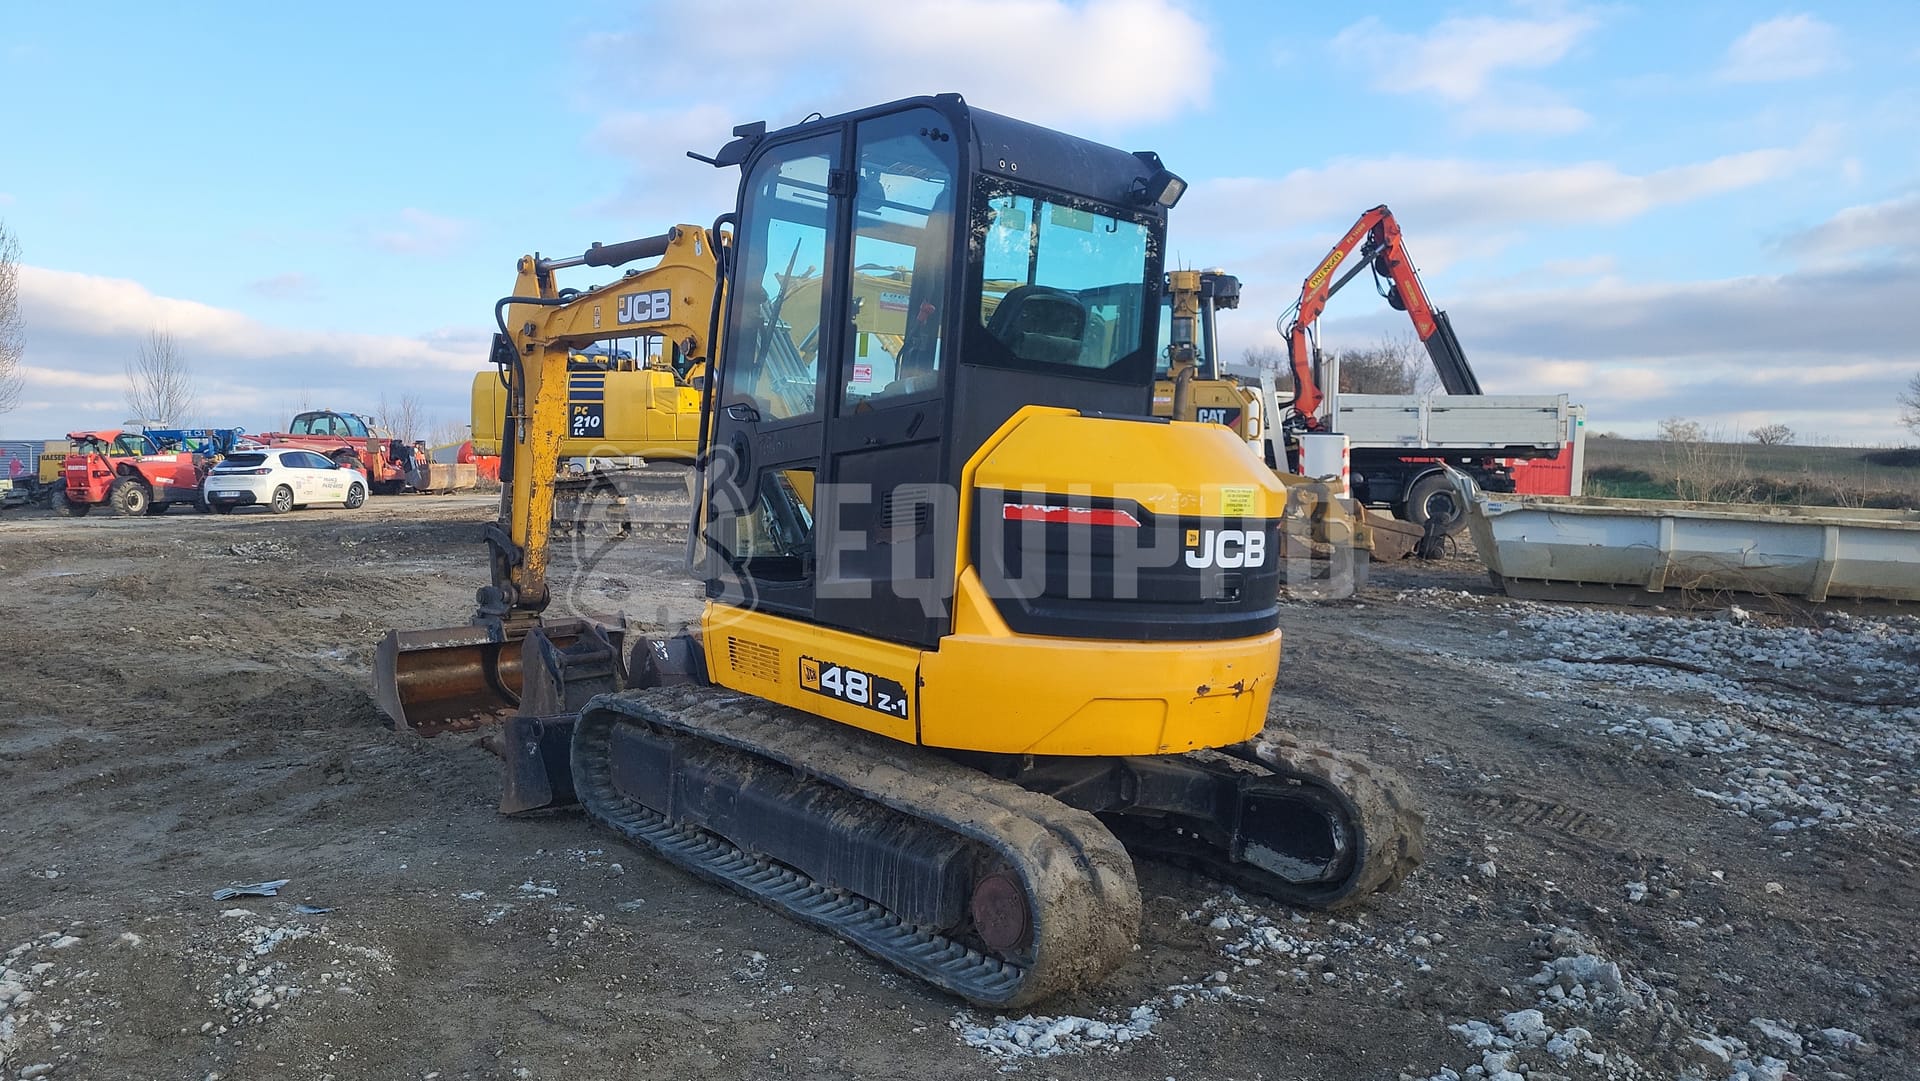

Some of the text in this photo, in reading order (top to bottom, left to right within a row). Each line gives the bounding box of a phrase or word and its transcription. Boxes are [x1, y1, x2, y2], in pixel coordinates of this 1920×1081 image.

[1311, 252, 1342, 286] PALFINGER
[618, 291, 671, 323] JCB
[573, 406, 589, 415] PC
[573, 416, 600, 428] 210
[1198, 408, 1227, 424] CAT
[573, 428, 585, 436] LC
[1185, 530, 1266, 569] JCB
[821, 666, 869, 704] 48
